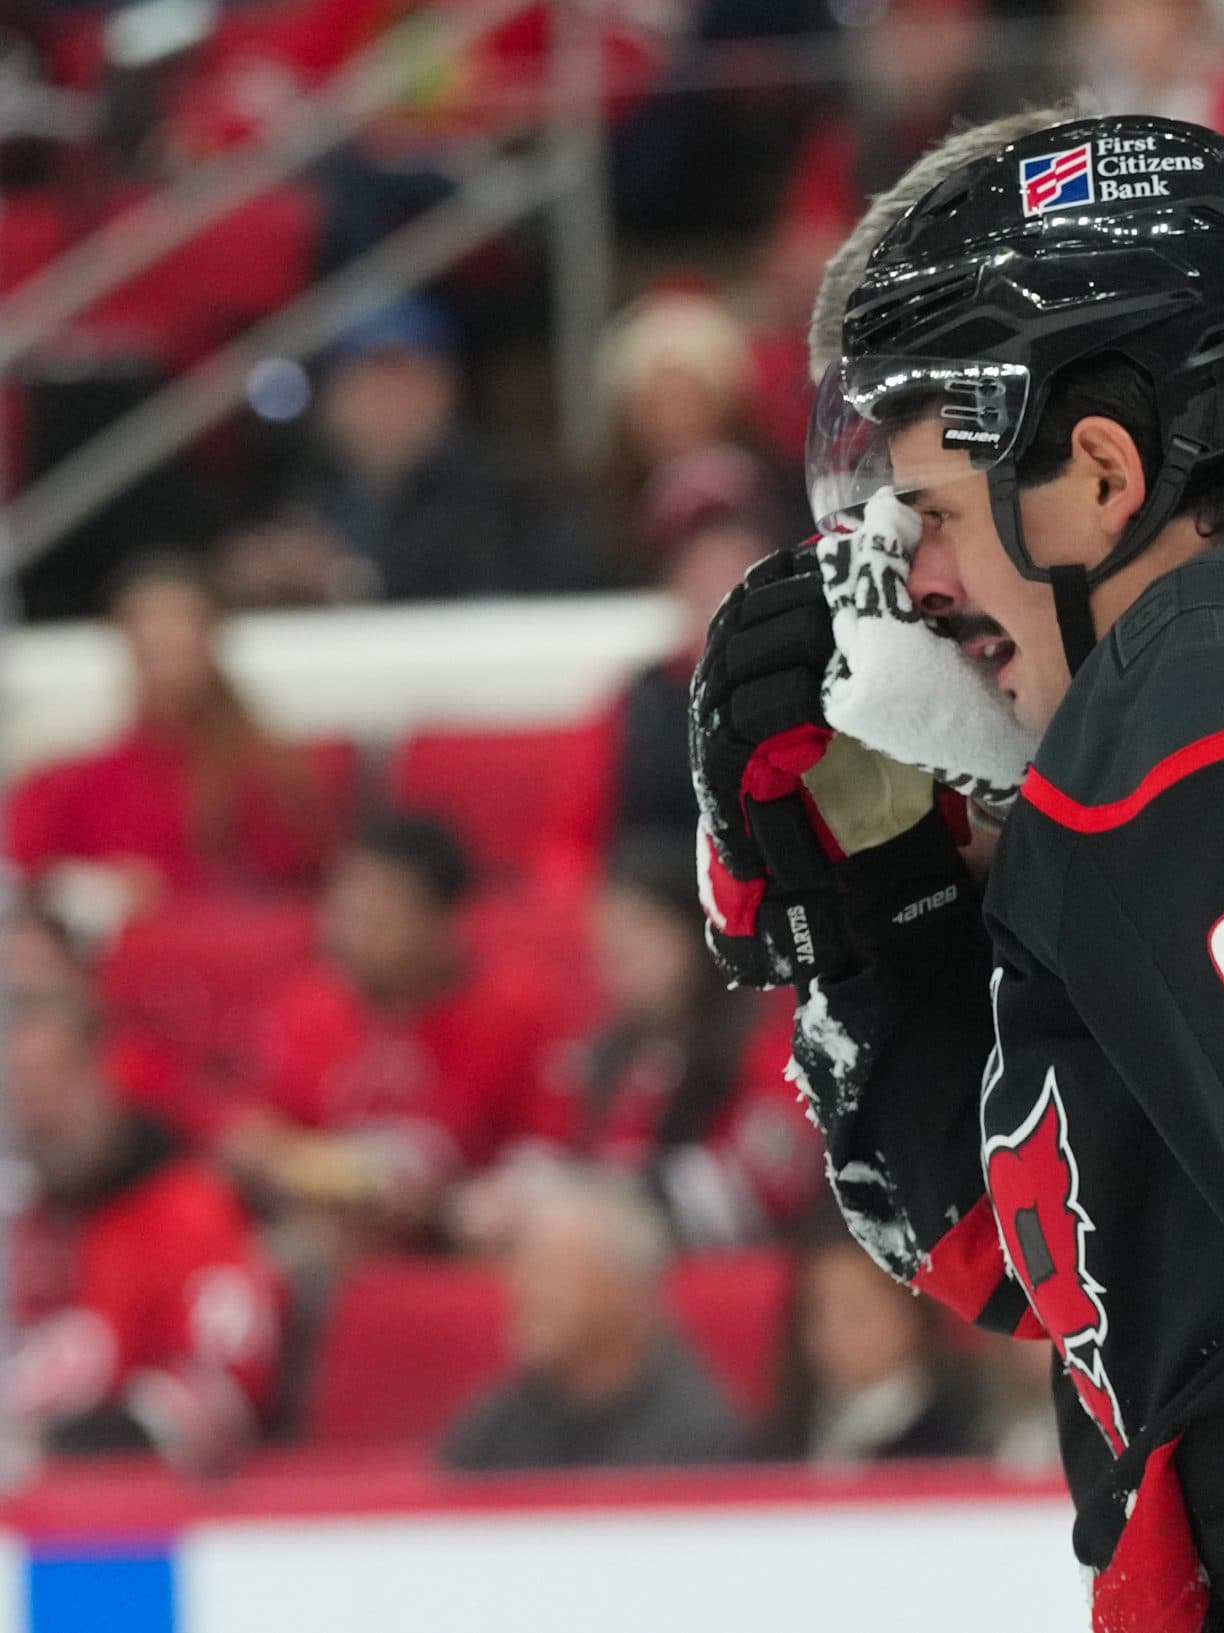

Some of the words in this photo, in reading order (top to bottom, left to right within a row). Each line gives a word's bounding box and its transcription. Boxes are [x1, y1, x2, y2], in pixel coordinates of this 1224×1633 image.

[1096, 136, 1157, 156] First
[1097, 154, 1204, 176] Citizens
[1099, 175, 1170, 202] Bank
[787, 905, 815, 965] JARVIS
